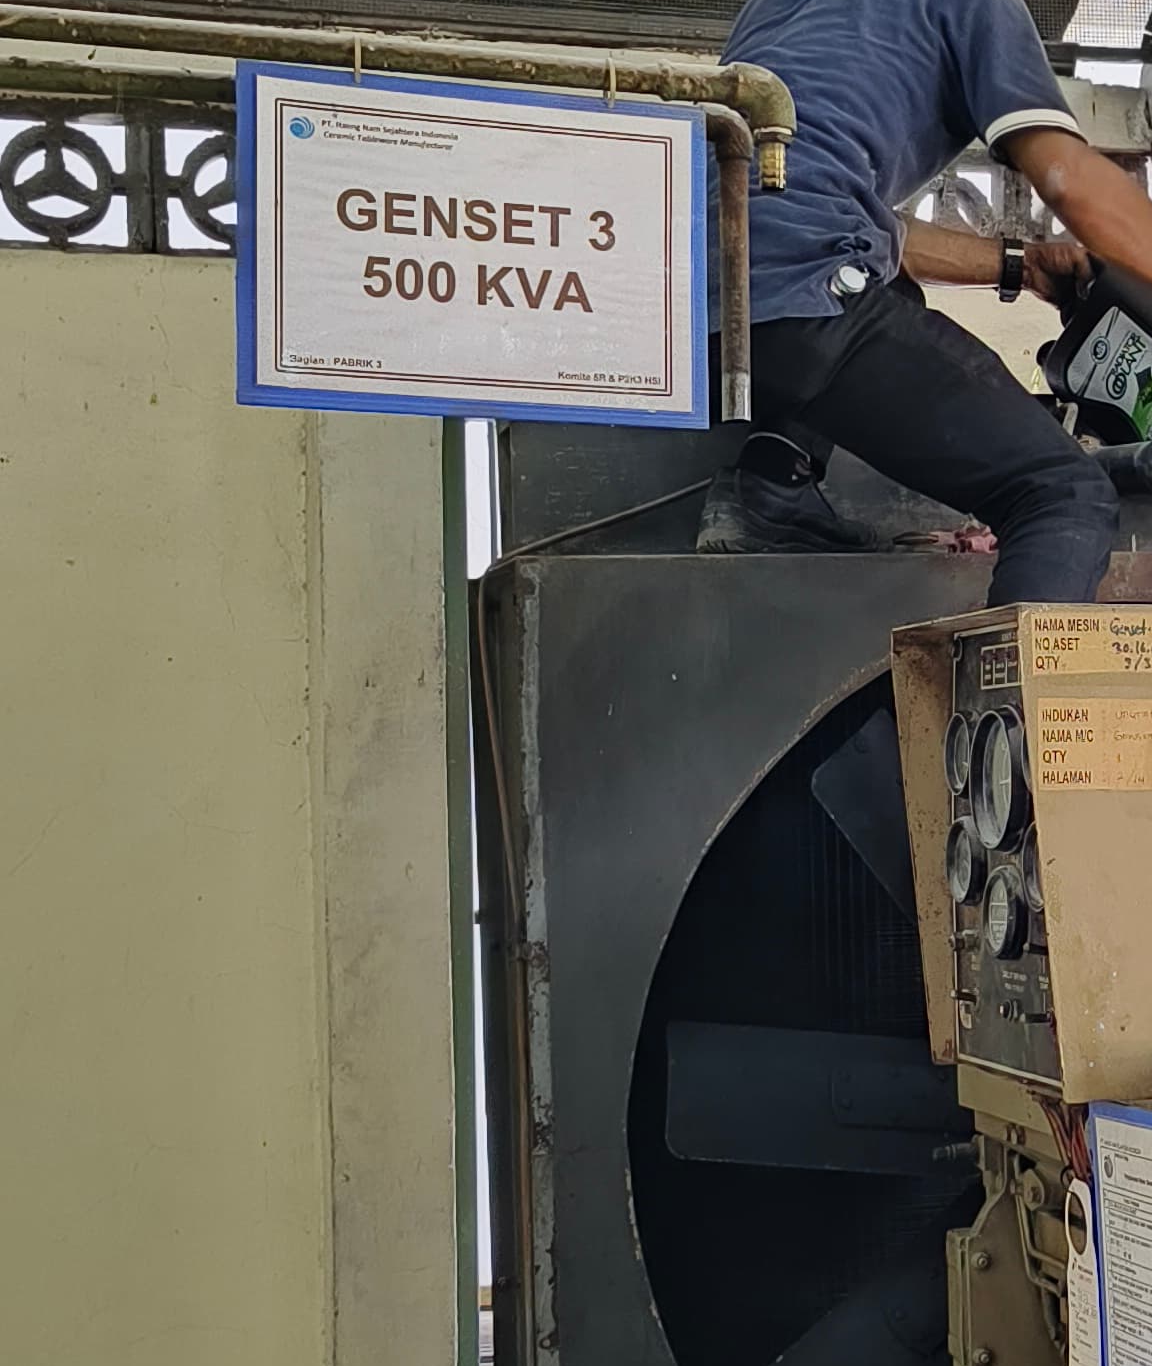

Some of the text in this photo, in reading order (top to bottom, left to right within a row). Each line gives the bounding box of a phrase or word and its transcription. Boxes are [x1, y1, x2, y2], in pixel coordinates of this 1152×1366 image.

[337, 188, 616, 251] GENSET 3
[363, 255, 593, 313] 500 KVA
[333, 357, 374, 369] PABRIK
[558, 371, 591, 381] Komite
[608, 374, 616, 383] &
[1034, 618, 1065, 632] NAMA
[1067, 618, 1100, 632] MESIN
[1053, 637, 1081, 651] ASET
[1035, 655, 1060, 671] QTY
[1042, 708, 1089, 723] INDUKAN
[1042, 728, 1073, 743] NAMA
[1042, 749, 1067, 765] QTY
[1042, 770, 1092, 785] HALAMAN
